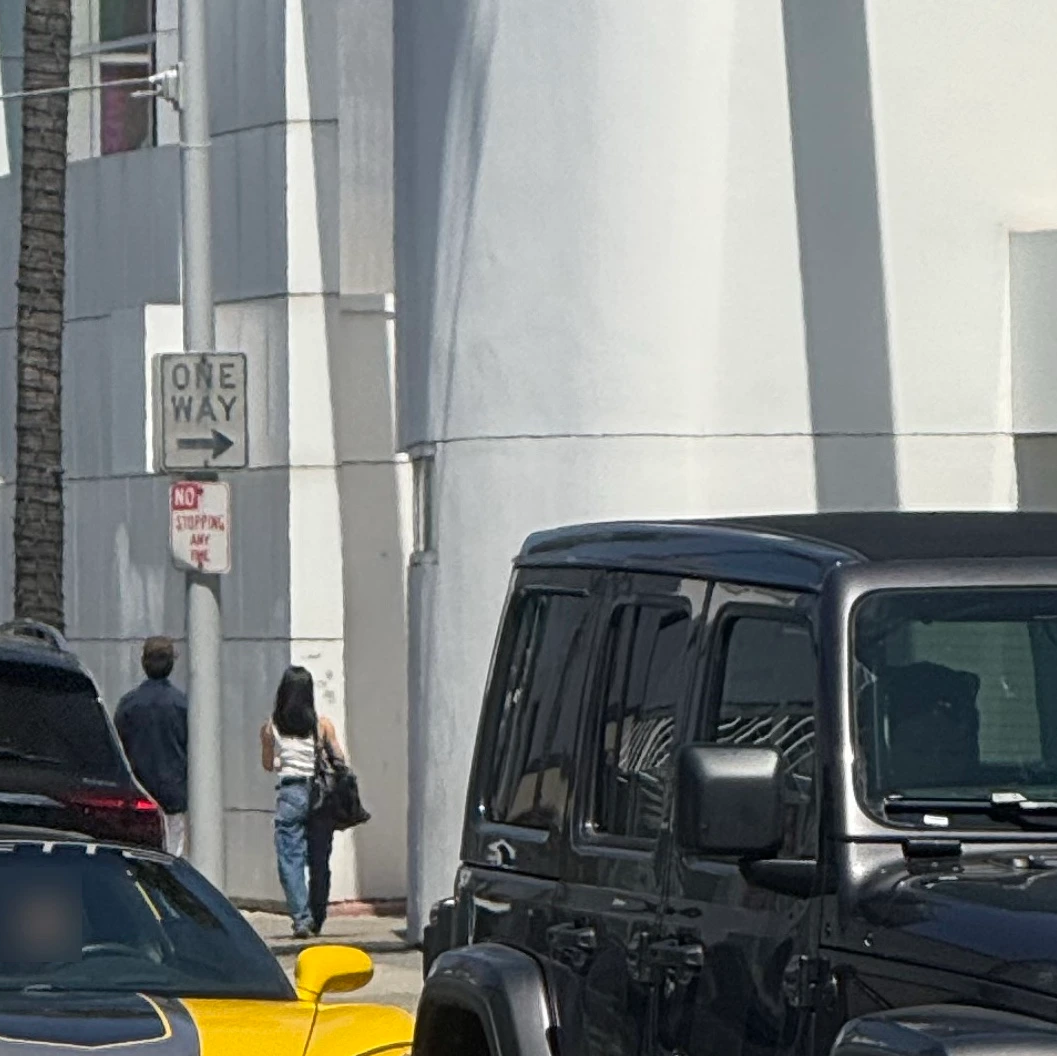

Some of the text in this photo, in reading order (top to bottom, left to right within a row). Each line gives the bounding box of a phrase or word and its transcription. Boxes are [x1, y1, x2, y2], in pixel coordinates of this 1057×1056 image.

[172, 363, 235, 389] ONE
[171, 396, 237, 422] WAY
[174, 487, 195, 506] NO
[176, 515, 225, 532] STOPPING
[191, 534, 211, 546] ANY
